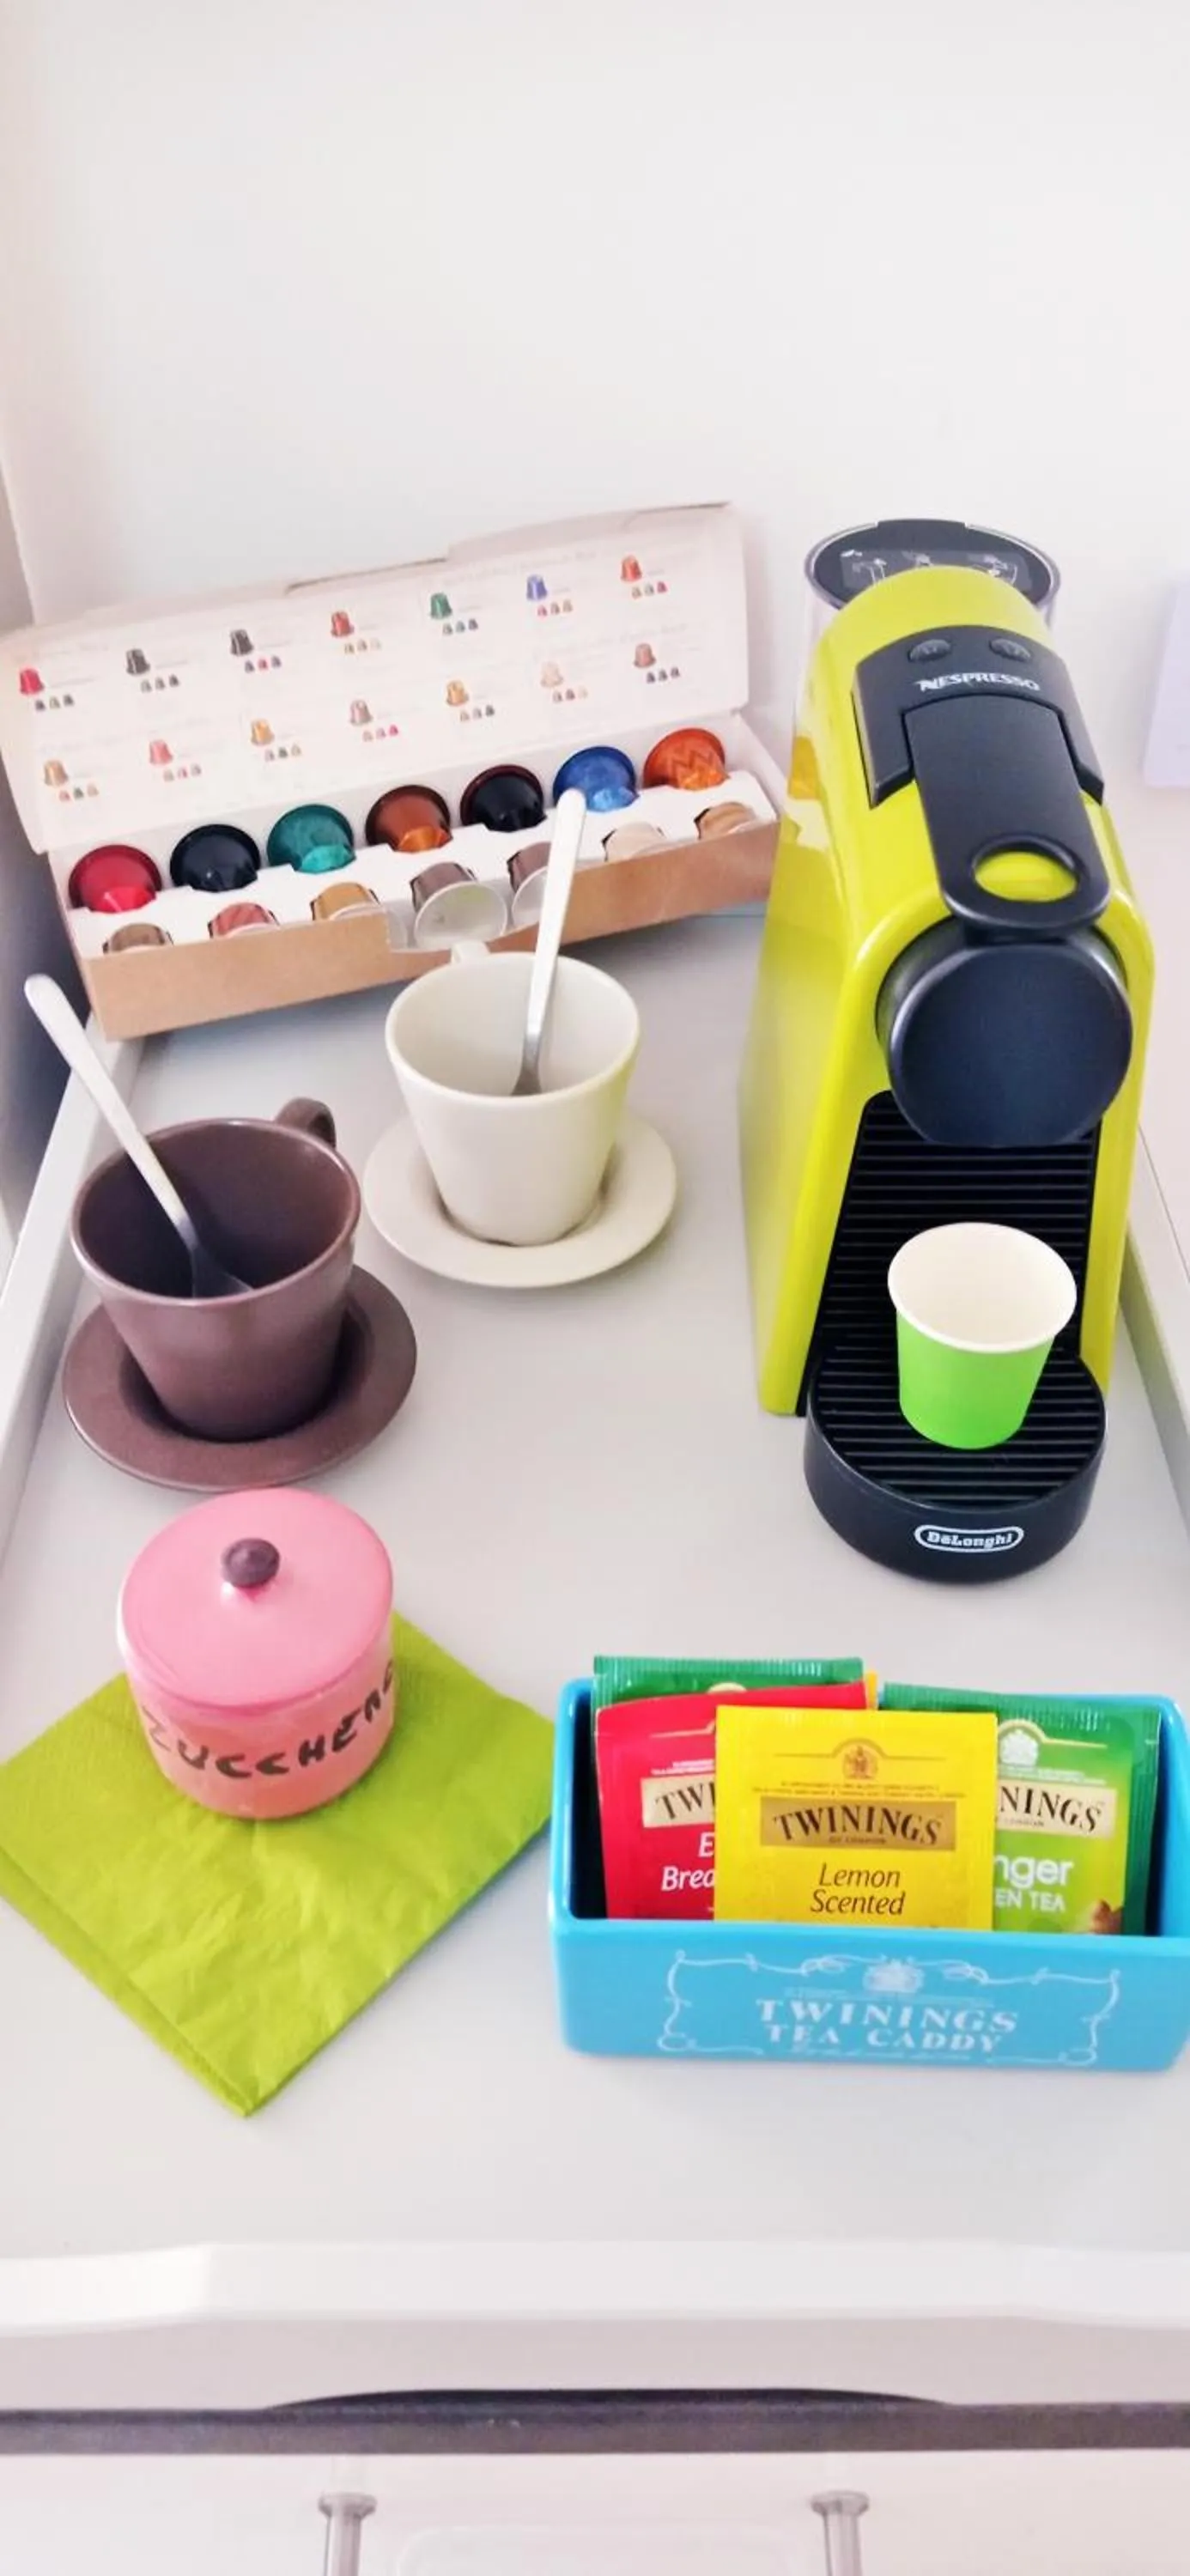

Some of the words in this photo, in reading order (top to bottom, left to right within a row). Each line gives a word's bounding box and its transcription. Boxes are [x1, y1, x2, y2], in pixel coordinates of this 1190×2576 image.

[914, 672, 1041, 692] NESPRESSO
[999, 1785, 1102, 1833] NINGS
[774, 1805, 942, 1846] TWININGS
[818, 1862, 901, 1888] Lemon
[810, 1888, 907, 1915] Scented
[1028, 1890, 1066, 1913] TEA
[756, 1998, 1019, 2033] TWININGS
[766, 2024, 841, 2044] TEA
[866, 2028, 1004, 2053] CADDY
